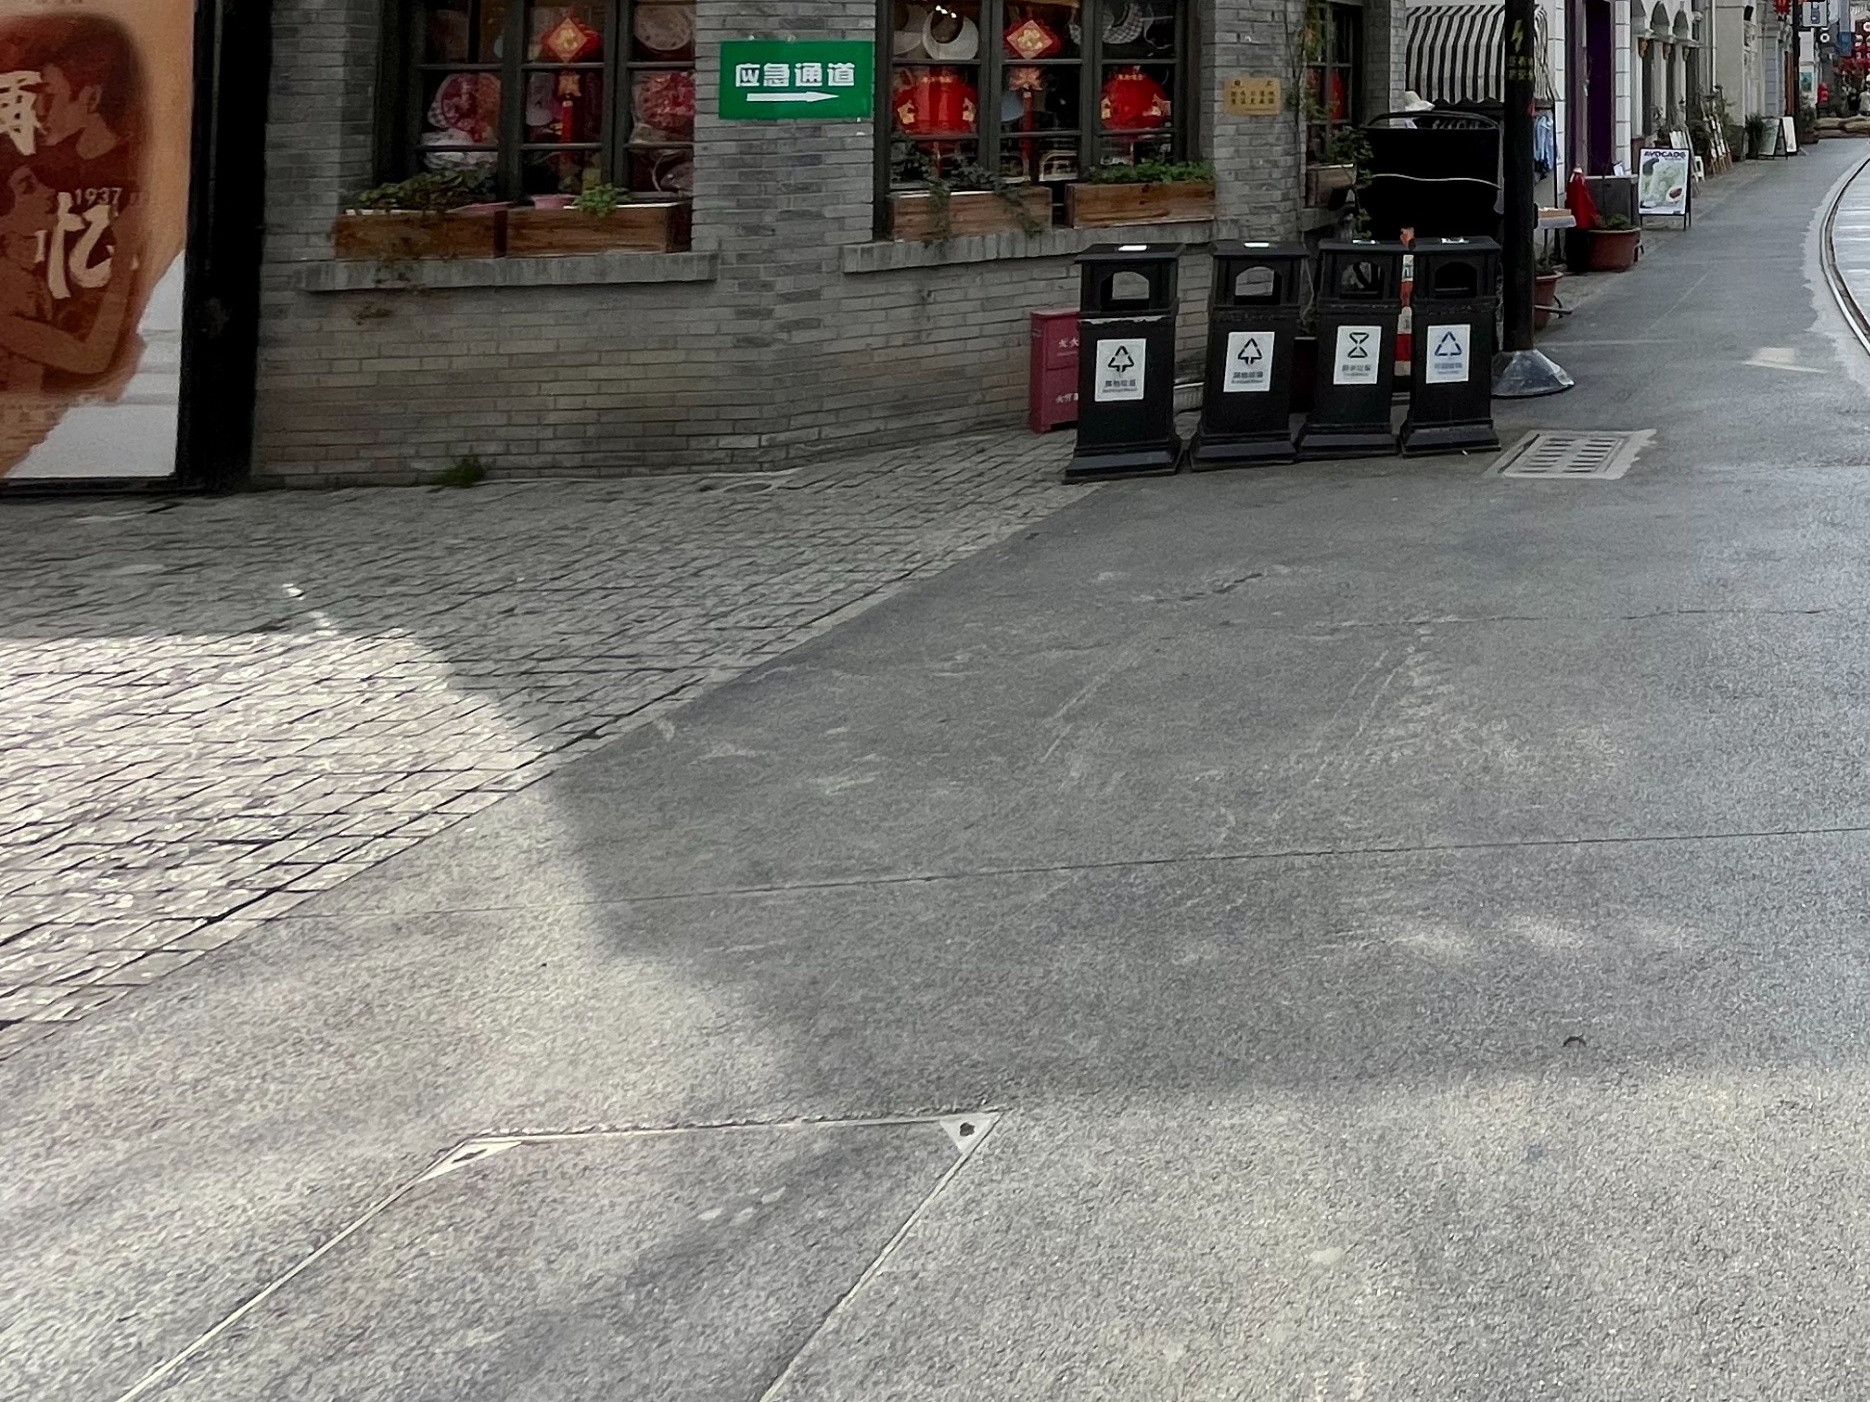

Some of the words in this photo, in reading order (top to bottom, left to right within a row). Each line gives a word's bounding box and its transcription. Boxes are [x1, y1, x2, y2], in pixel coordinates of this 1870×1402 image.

[735, 62, 856, 87] 应急通道
[74, 186, 123, 206] 1937
